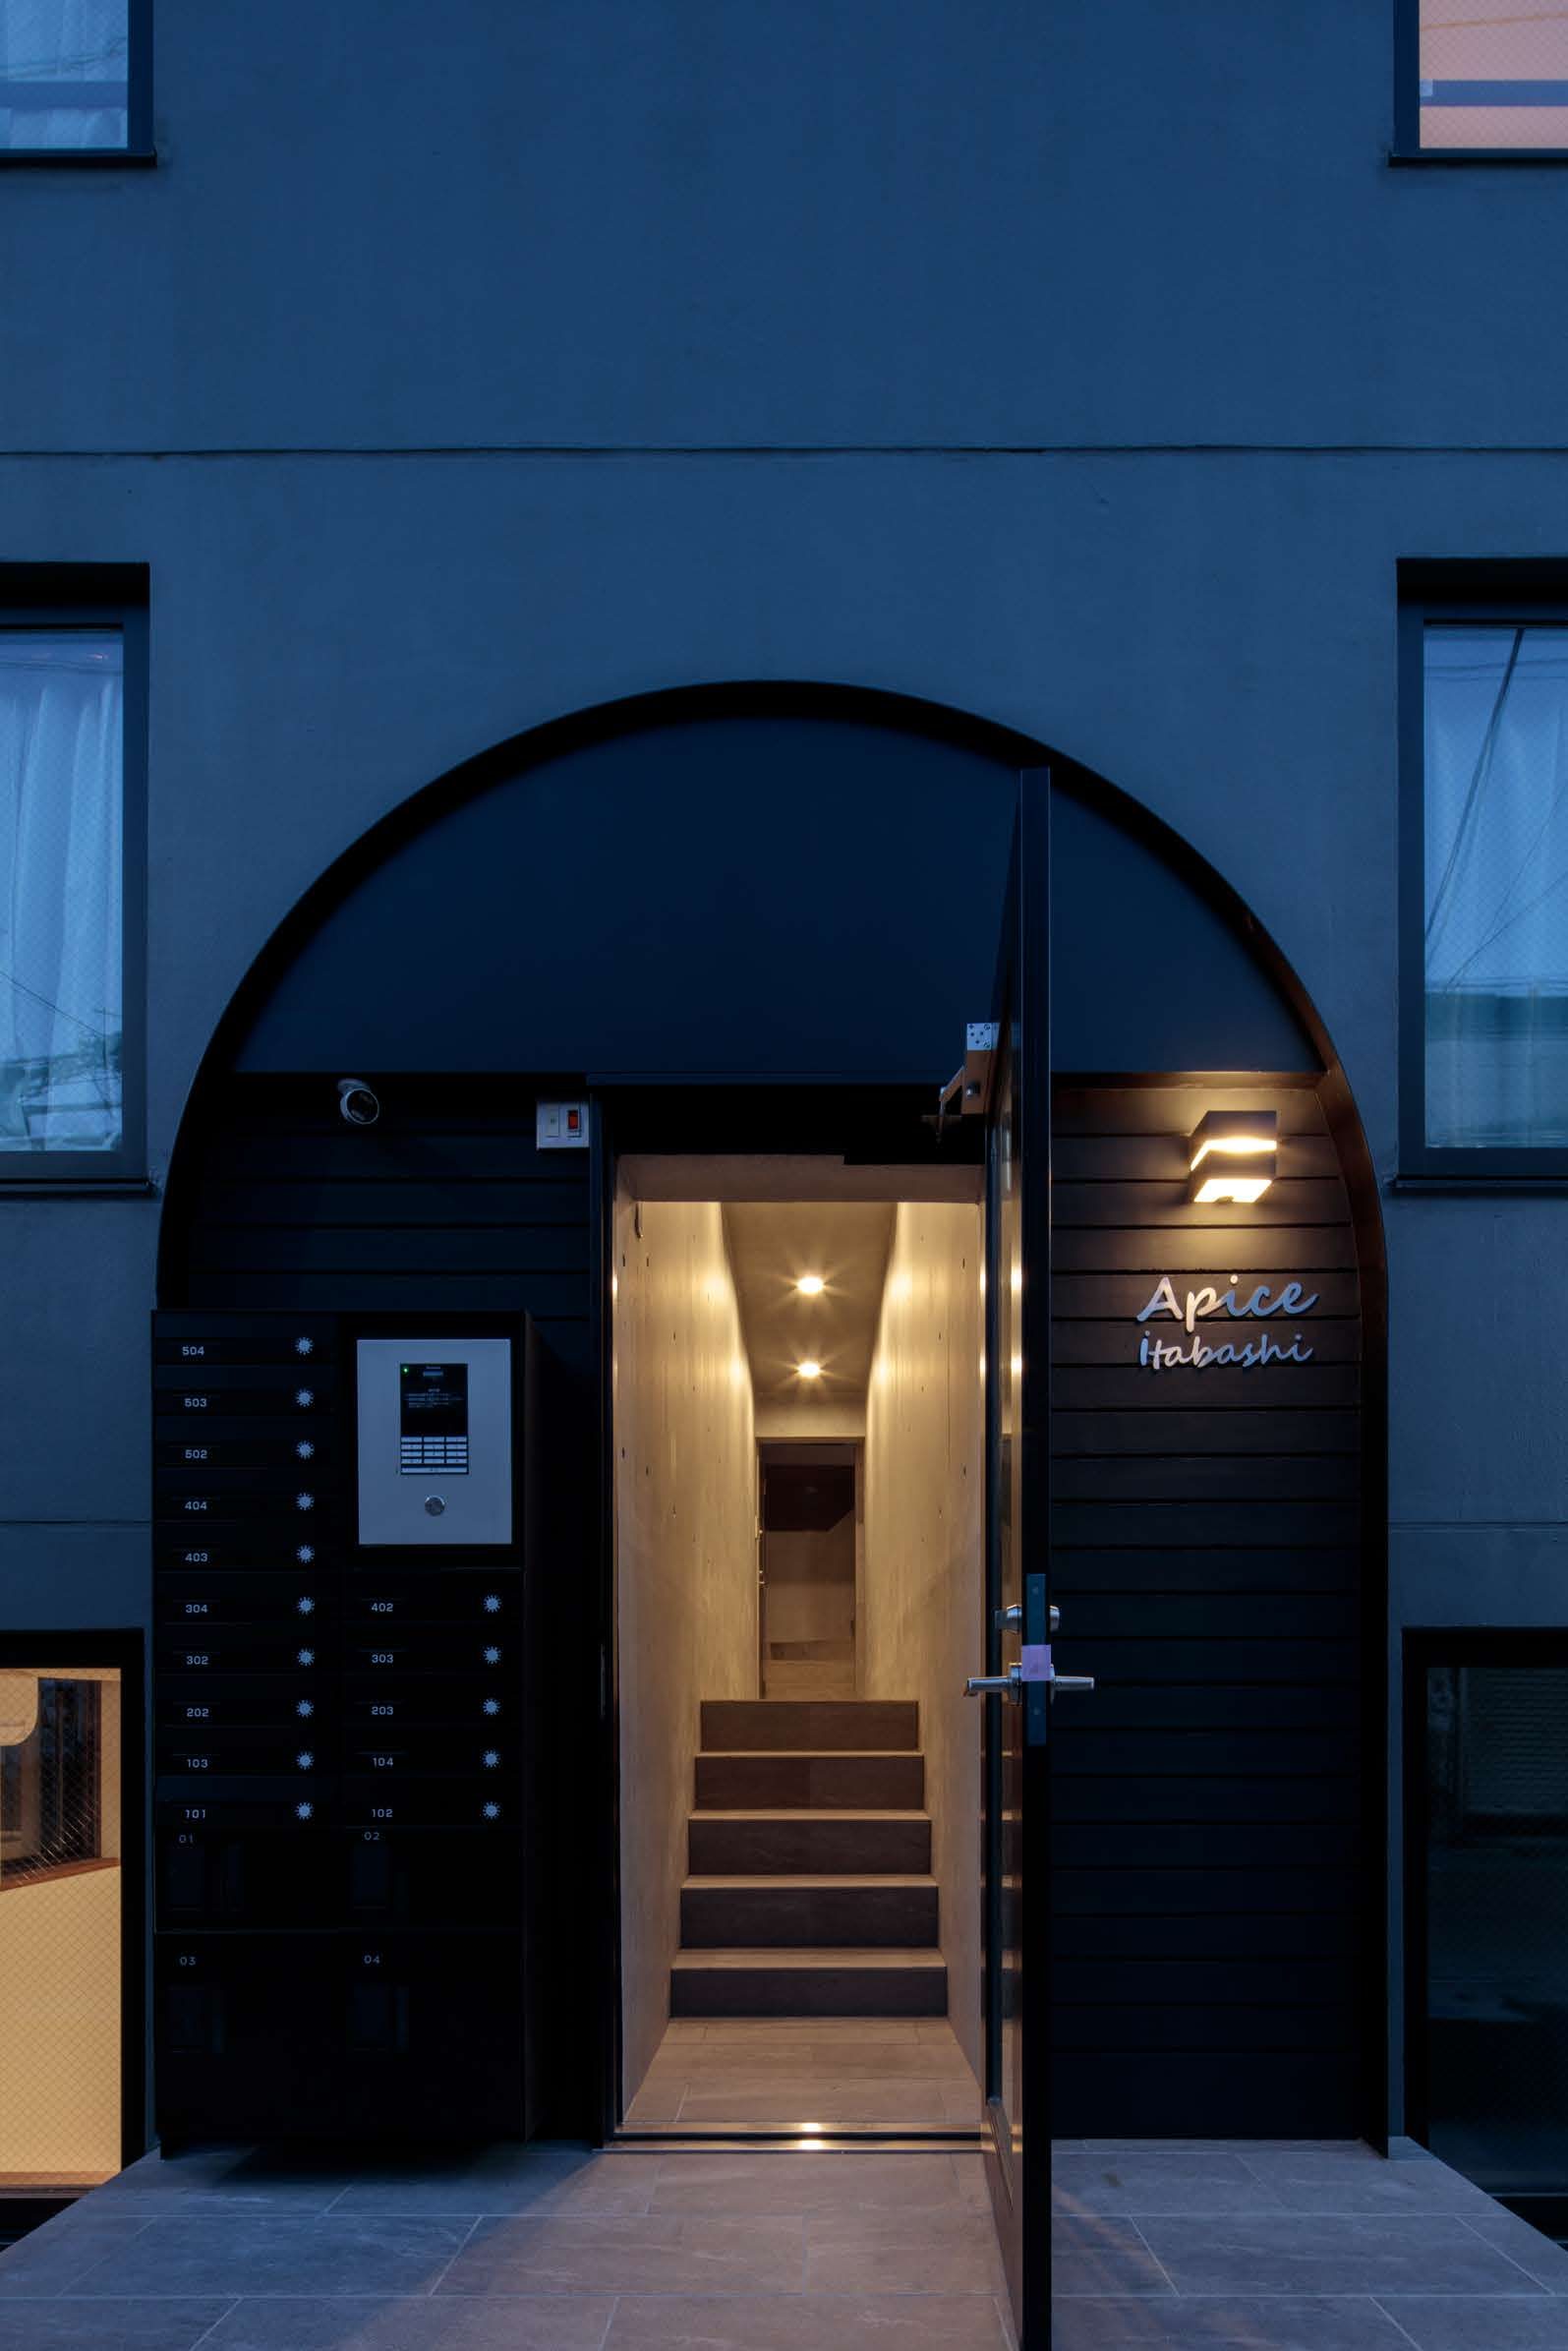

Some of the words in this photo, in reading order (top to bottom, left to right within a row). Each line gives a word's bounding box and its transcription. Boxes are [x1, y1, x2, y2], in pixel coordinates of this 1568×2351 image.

[1136, 1274, 1319, 1332] Apice
[182, 1345, 205, 1356] 504
[184, 1397, 207, 1408] 503
[185, 1448, 207, 1459] 502
[184, 1500, 207, 1510] 404
[185, 1552, 208, 1562] 403
[185, 1604, 208, 1614] 304
[371, 1602, 394, 1613] 402
[186, 1655, 209, 1666] 302
[372, 1654, 394, 1664] 303
[187, 1707, 209, 1718] 202
[371, 1706, 394, 1716] 203
[187, 1758, 208, 1769] 103
[373, 1757, 394, 1767] 104
[185, 1808, 205, 1819] 101
[372, 1808, 393, 1818] 102
[178, 1834, 194, 1844] 01
[364, 1831, 379, 1841] 02
[179, 1956, 197, 1967] 03
[363, 1954, 380, 1965] 04
